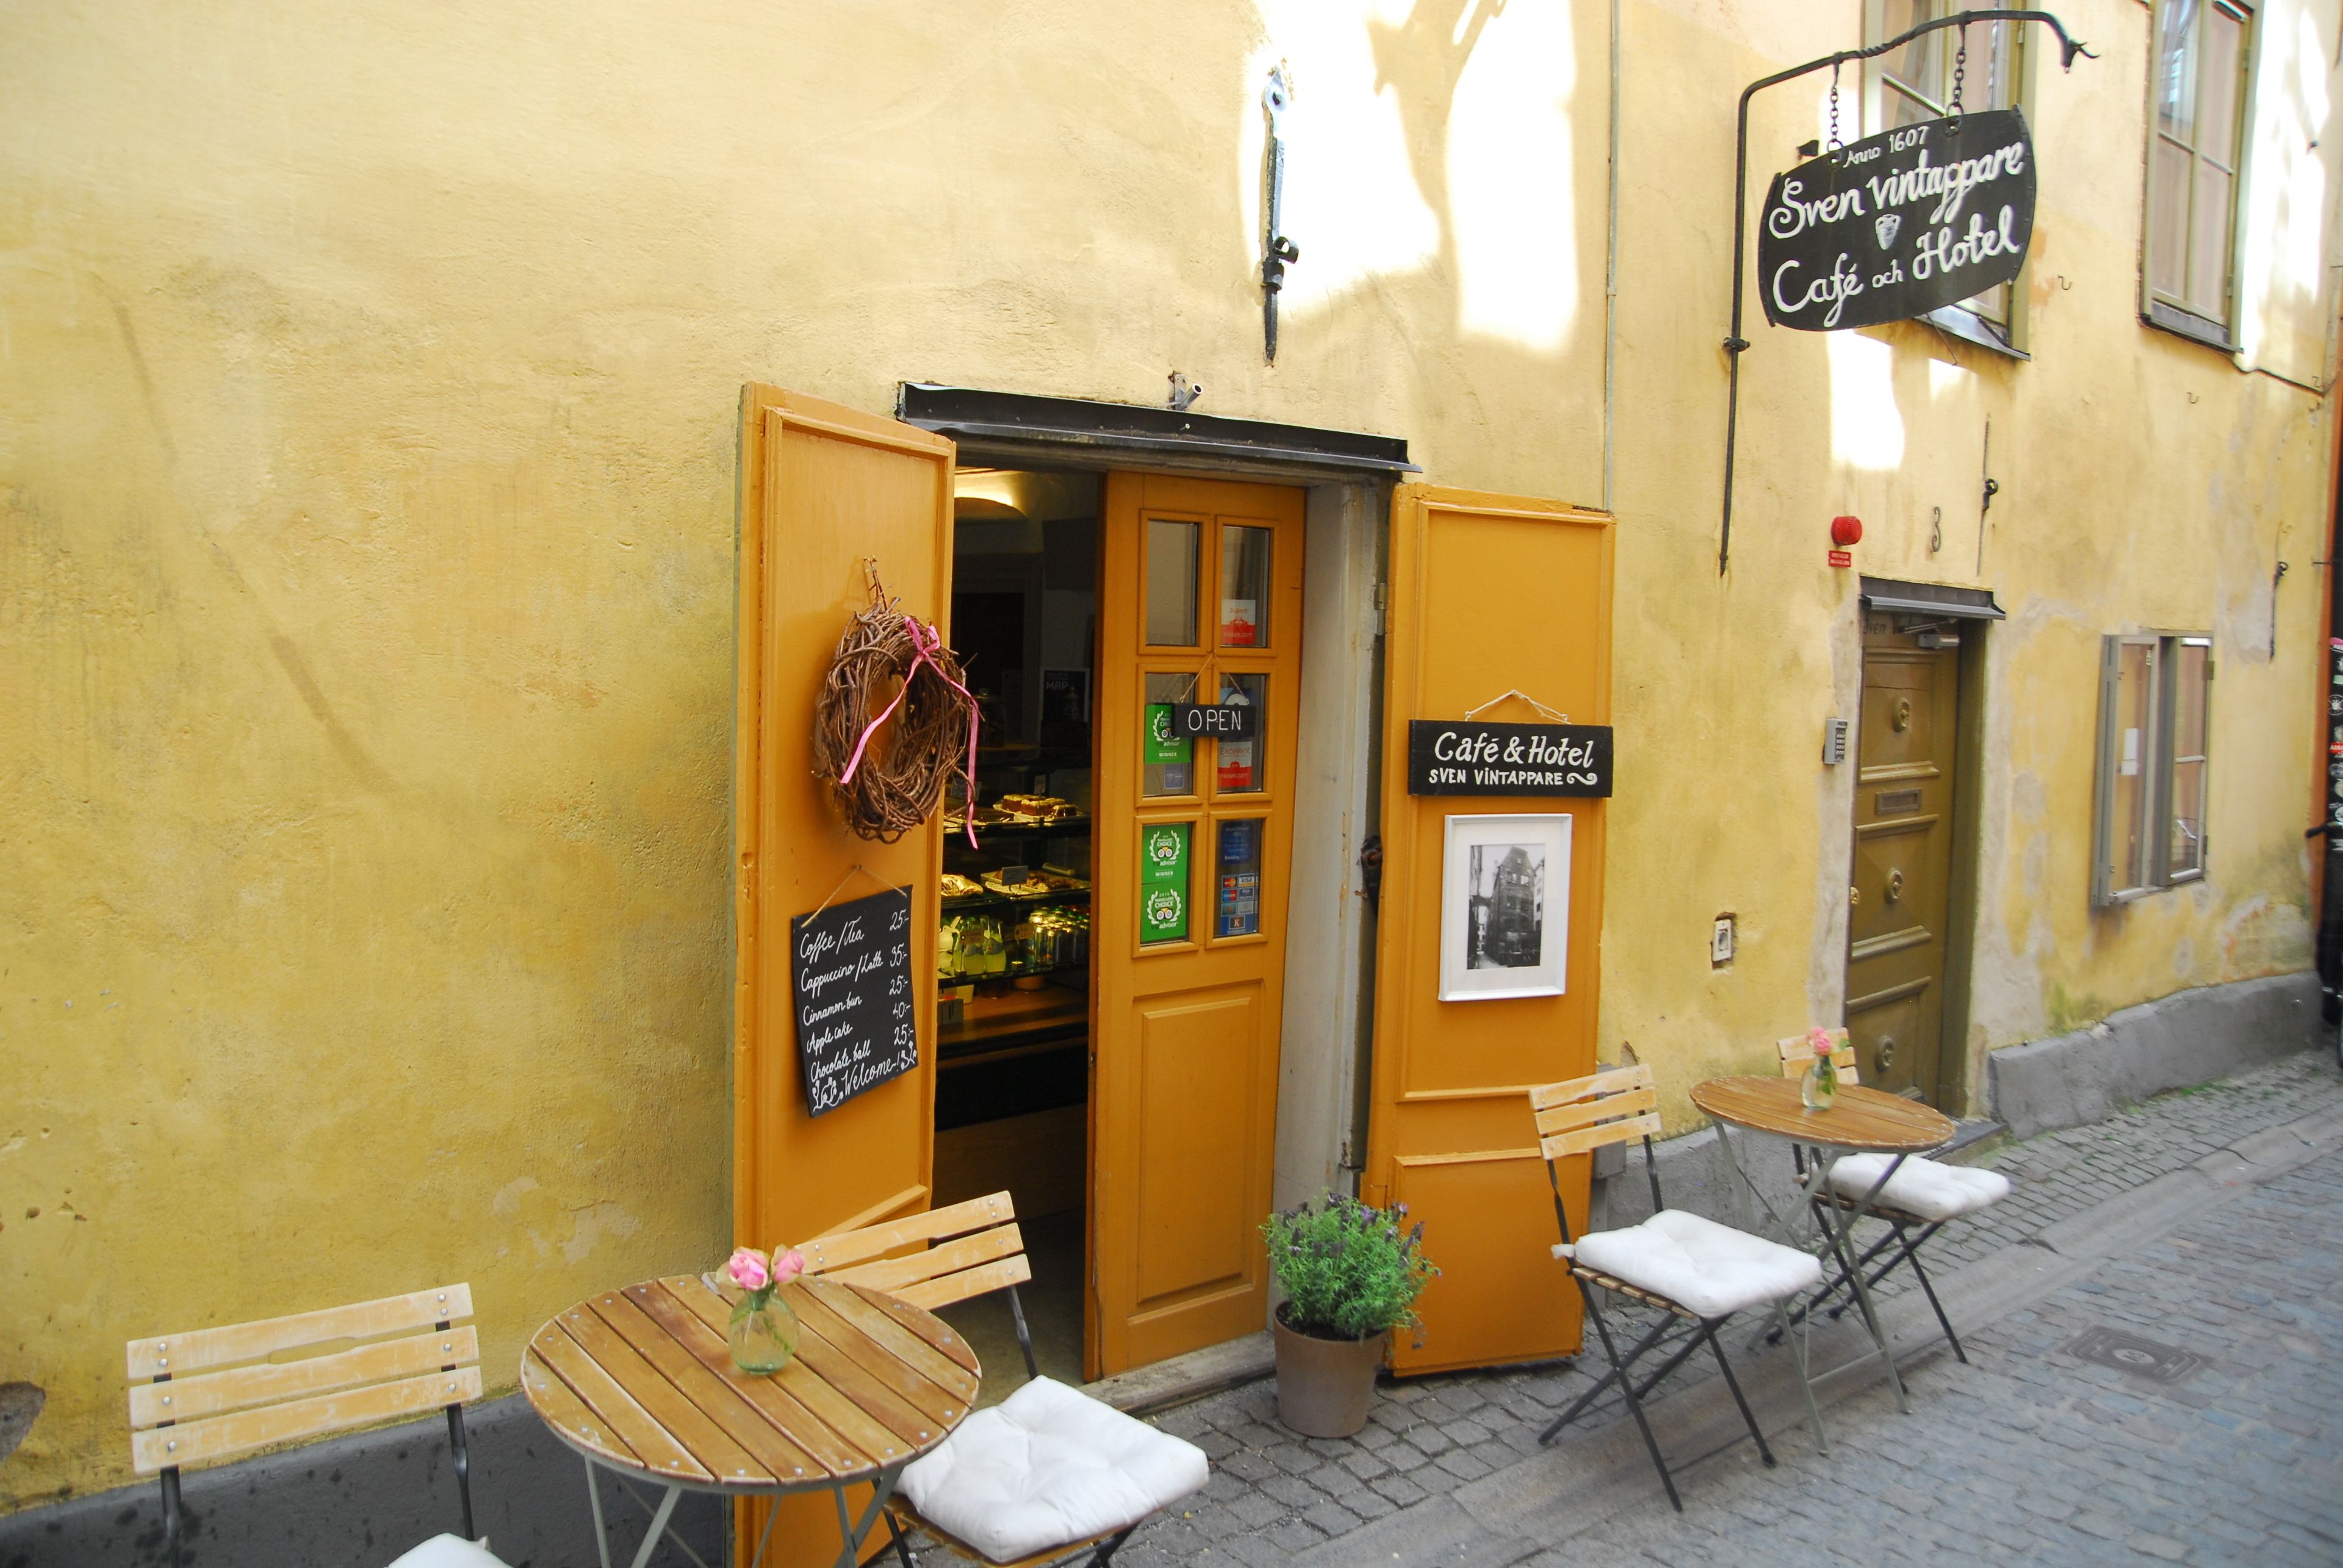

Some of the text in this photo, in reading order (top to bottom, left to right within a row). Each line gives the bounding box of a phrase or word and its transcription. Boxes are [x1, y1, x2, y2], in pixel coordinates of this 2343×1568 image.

[1843, 126, 1929, 168] Anno 1607
[1769, 178, 1865, 239] Sven
[1773, 204, 2020, 327] Café och Hotel
[1932, 506, 1941, 552] 3
[1046, 681, 1068, 691] MAP
[1188, 709, 1242, 731] OPEN
[1434, 732, 1594, 768] Café & Hotel
[1428, 768, 1466, 784] SVEN
[803, 1002, 846, 1026] Cinnamon
[846, 991, 862, 1010] bun
[807, 1026, 834, 1056] Apple
[834, 1021, 853, 1039] cake
[811, 1048, 852, 1083] Chocolate
[853, 1039, 871, 1062] ball
